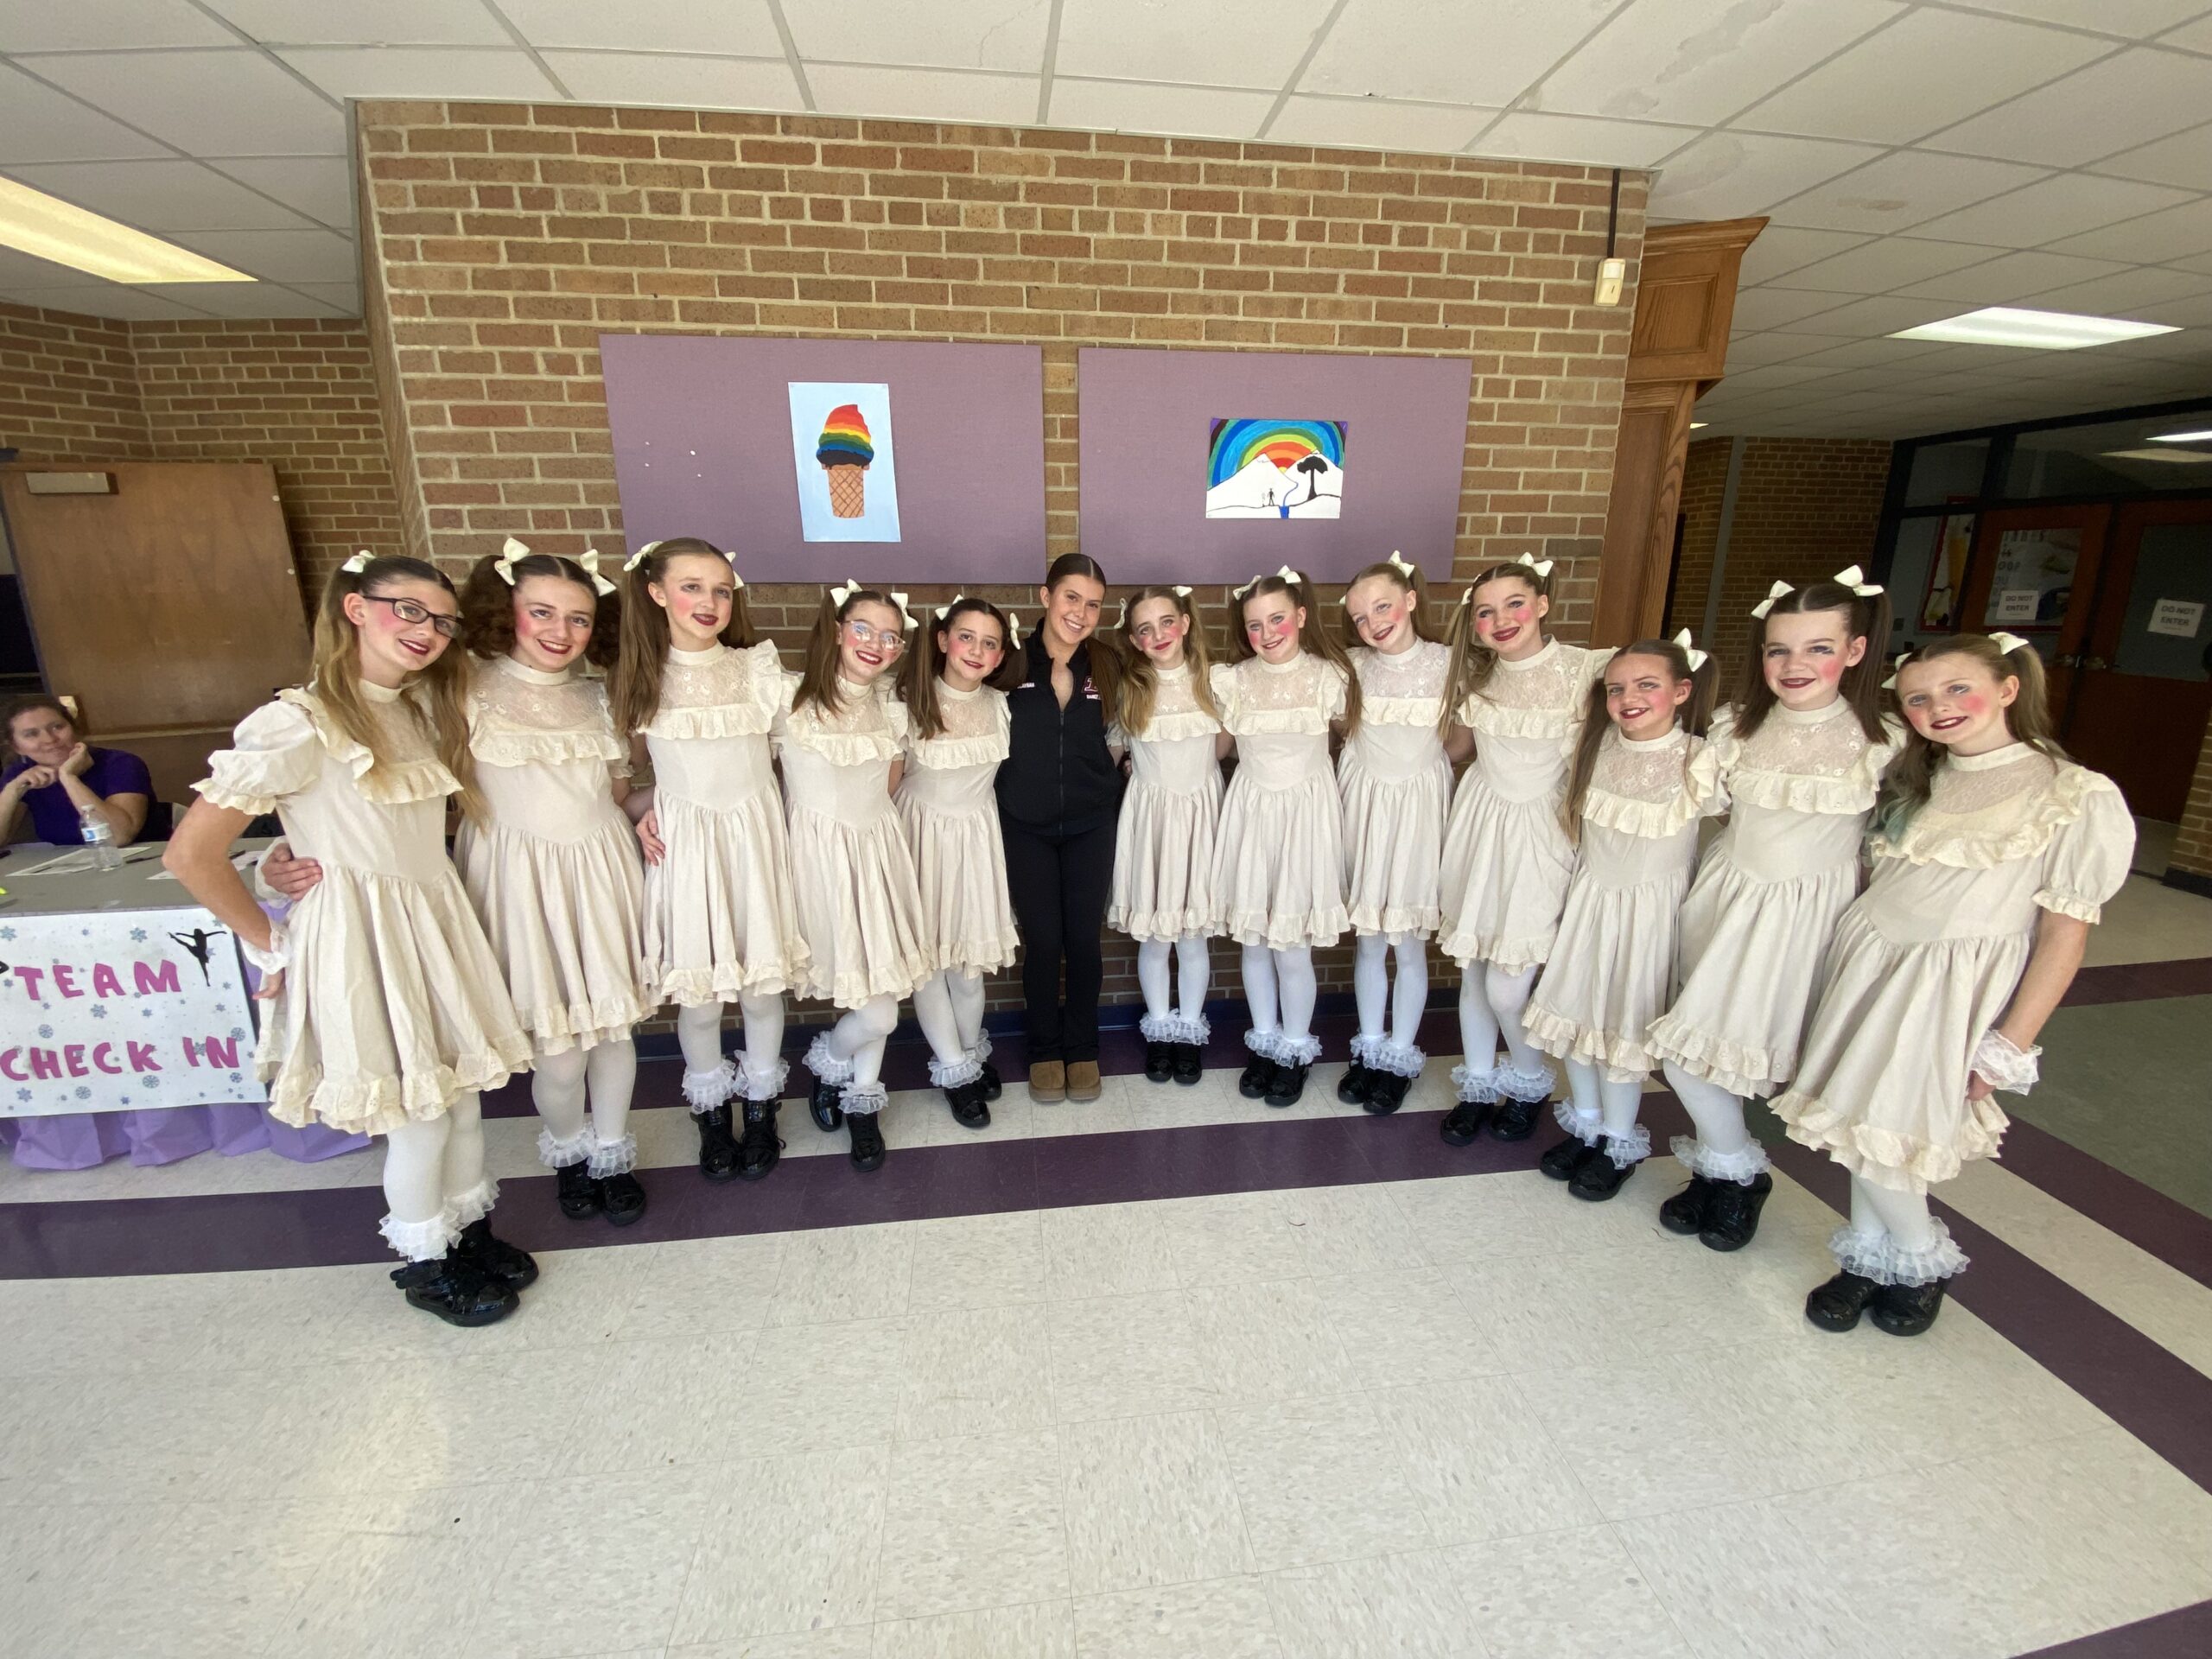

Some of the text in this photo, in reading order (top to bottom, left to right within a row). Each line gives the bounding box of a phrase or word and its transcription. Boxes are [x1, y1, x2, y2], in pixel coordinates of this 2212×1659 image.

[2160, 616, 2190, 626] ENTER
[2176, 607, 2196, 615] NOT
[14, 959, 181, 1001] TEAM
[0, 1036, 240, 1081] CHECK IN
